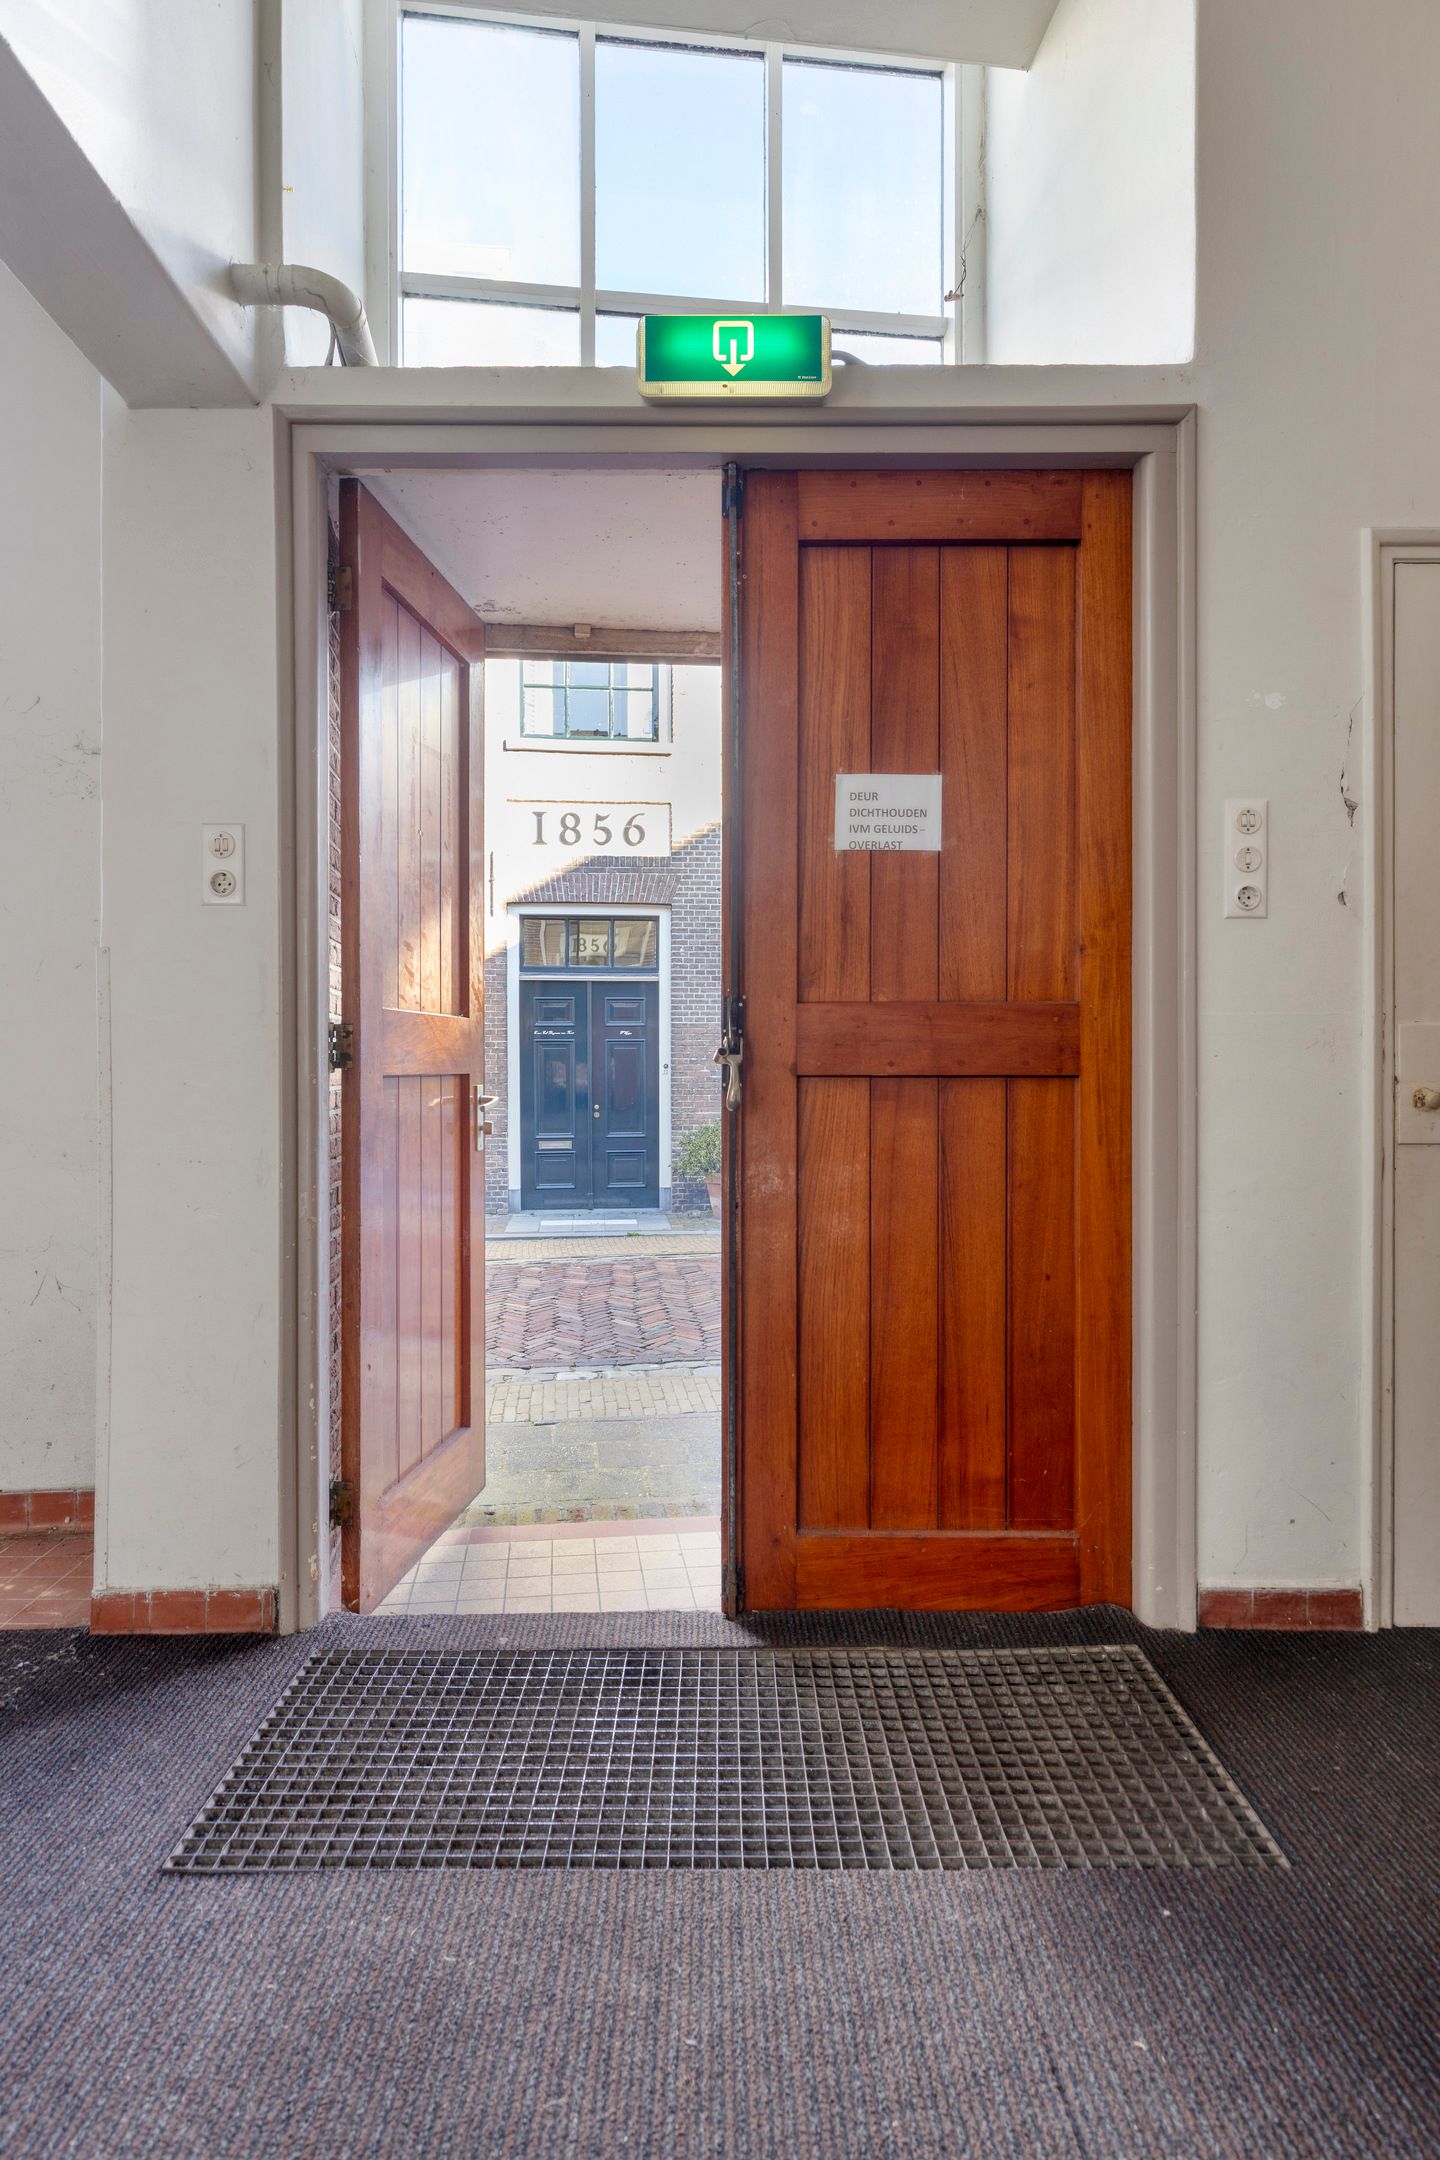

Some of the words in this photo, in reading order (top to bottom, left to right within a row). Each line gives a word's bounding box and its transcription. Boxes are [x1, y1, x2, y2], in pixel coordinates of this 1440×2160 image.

[849, 791, 879, 801] DEUR
[849, 808, 928, 818] DICHTHOUDEN
[531, 811, 646, 847] 1856
[849, 824, 871, 834] IVM
[848, 840, 903, 850] OVERLAST
